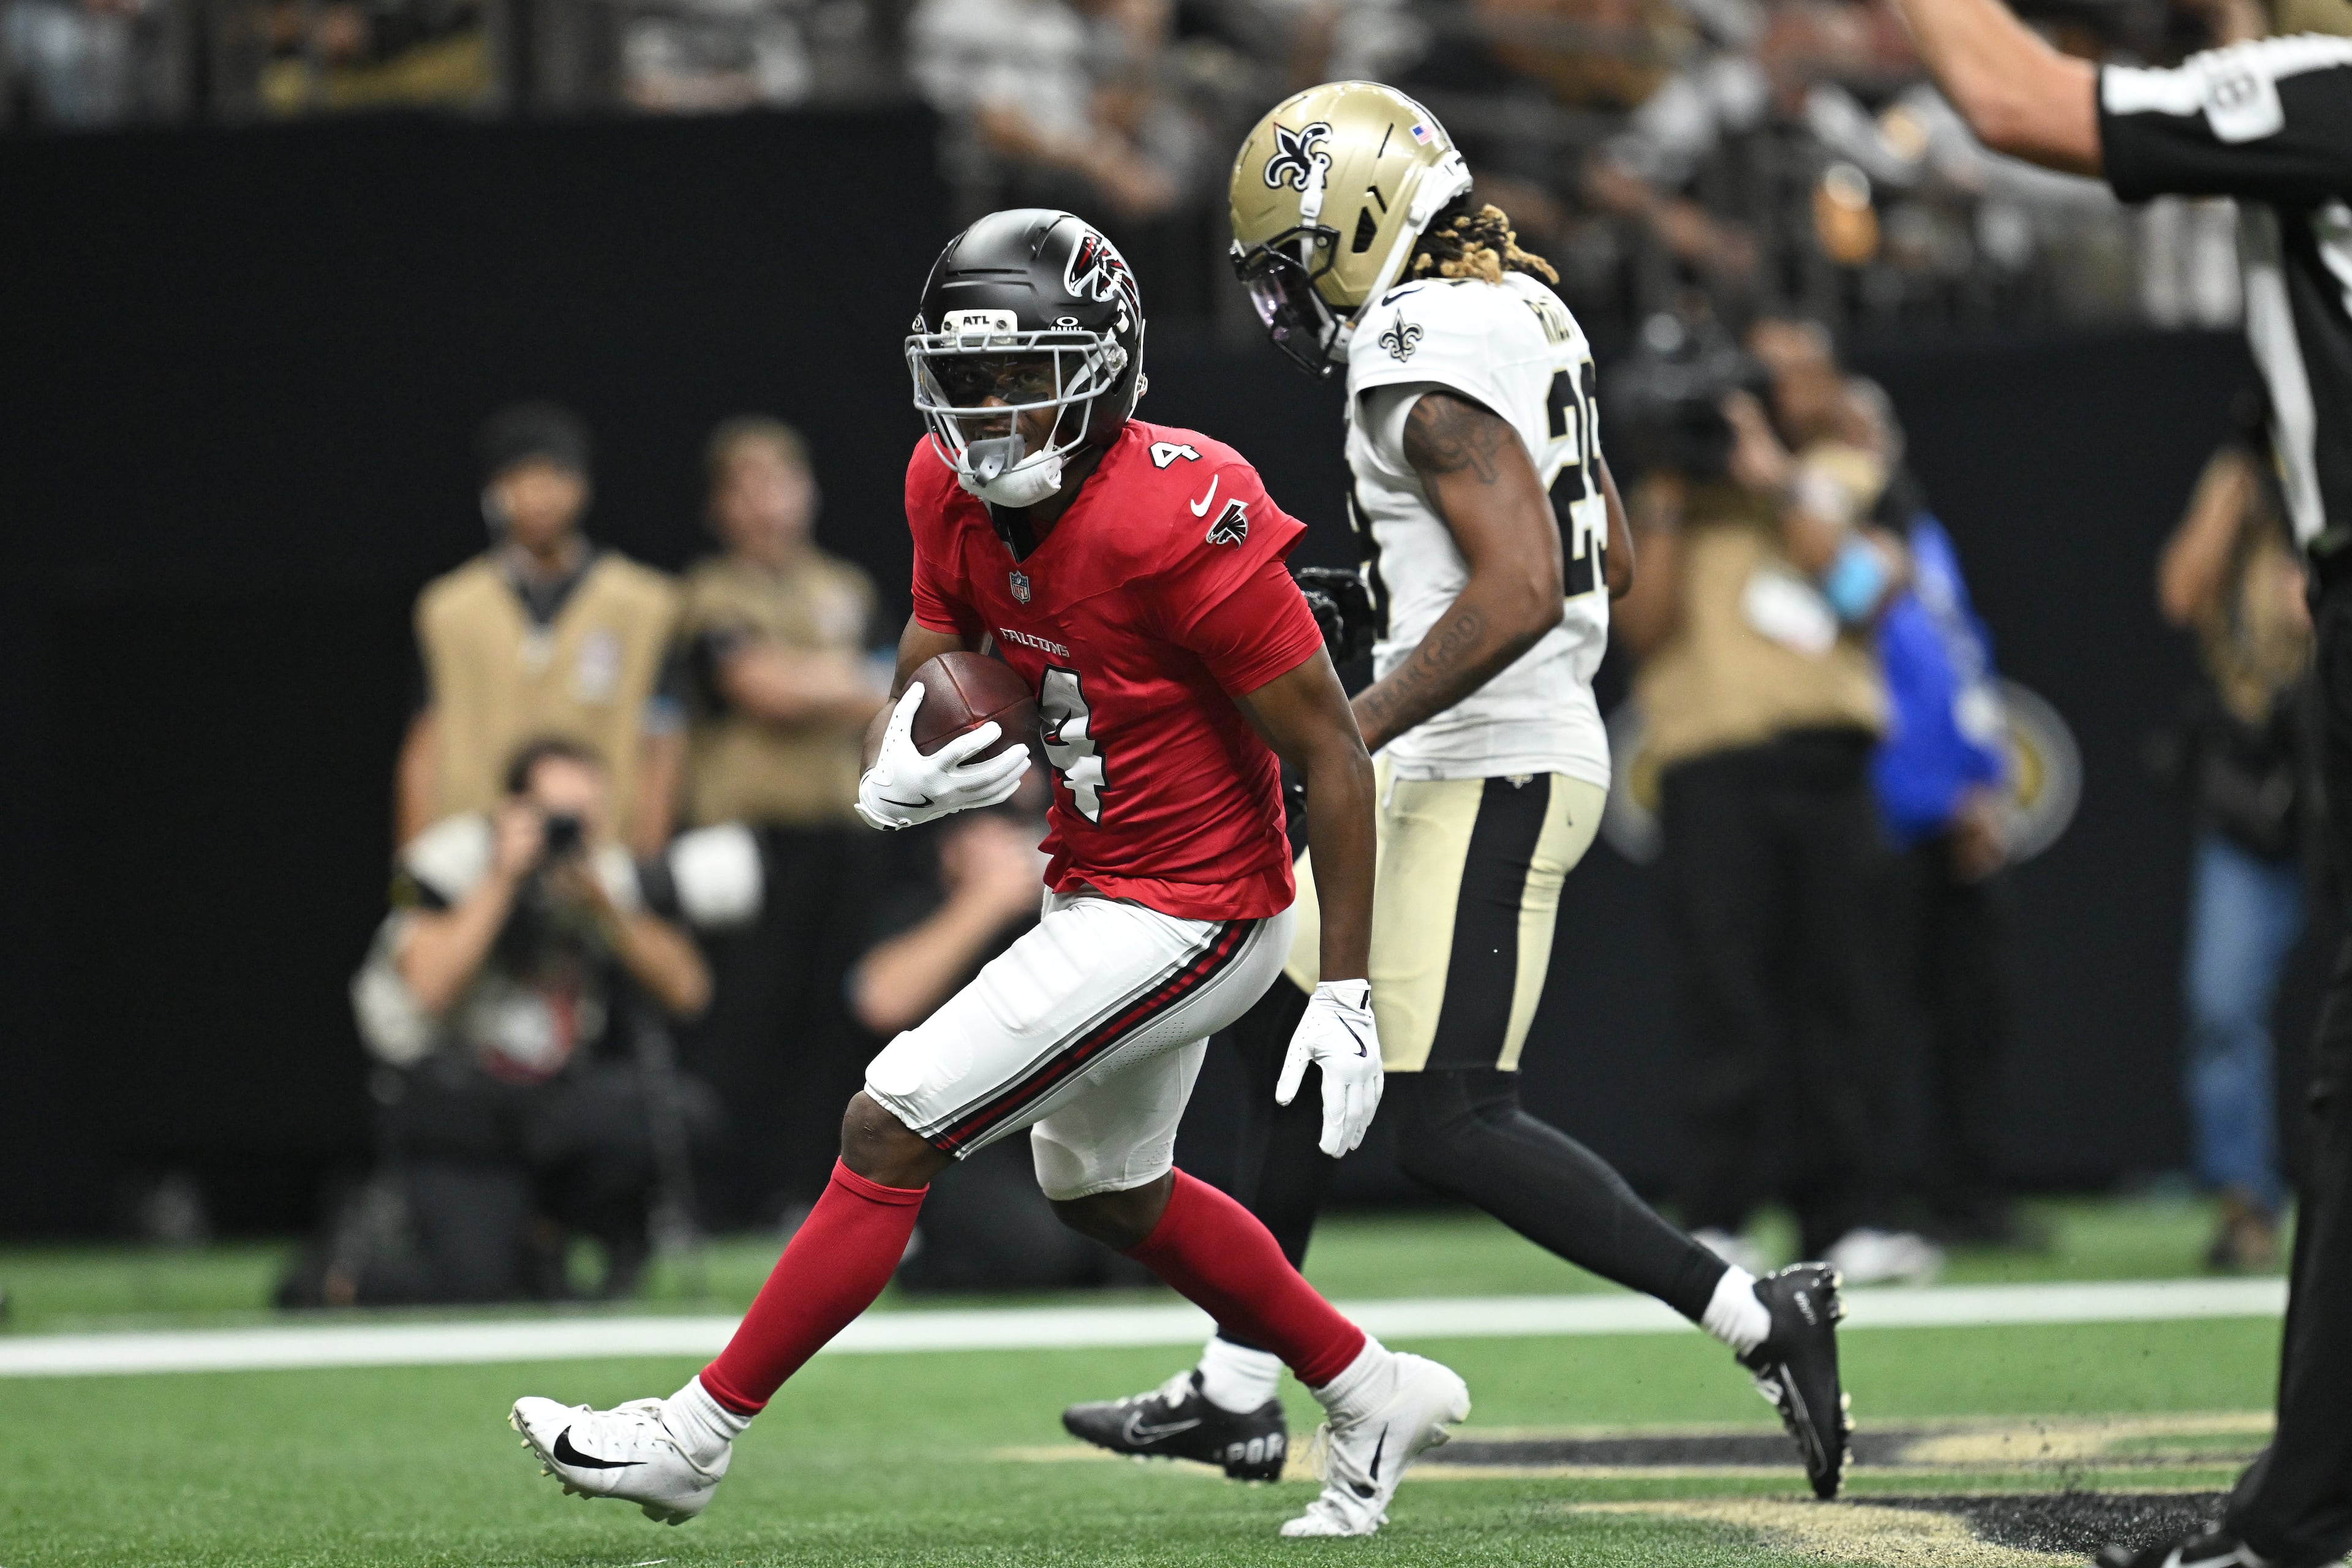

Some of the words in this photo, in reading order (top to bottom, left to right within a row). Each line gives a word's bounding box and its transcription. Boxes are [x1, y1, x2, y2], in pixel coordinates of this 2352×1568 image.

[963, 315, 990, 325] ATL
[1148, 440, 1203, 470] 4
[999, 627, 1070, 657] FALCONS
[1422, 614, 1476, 665] GOD
[1038, 663, 1112, 827] 4
